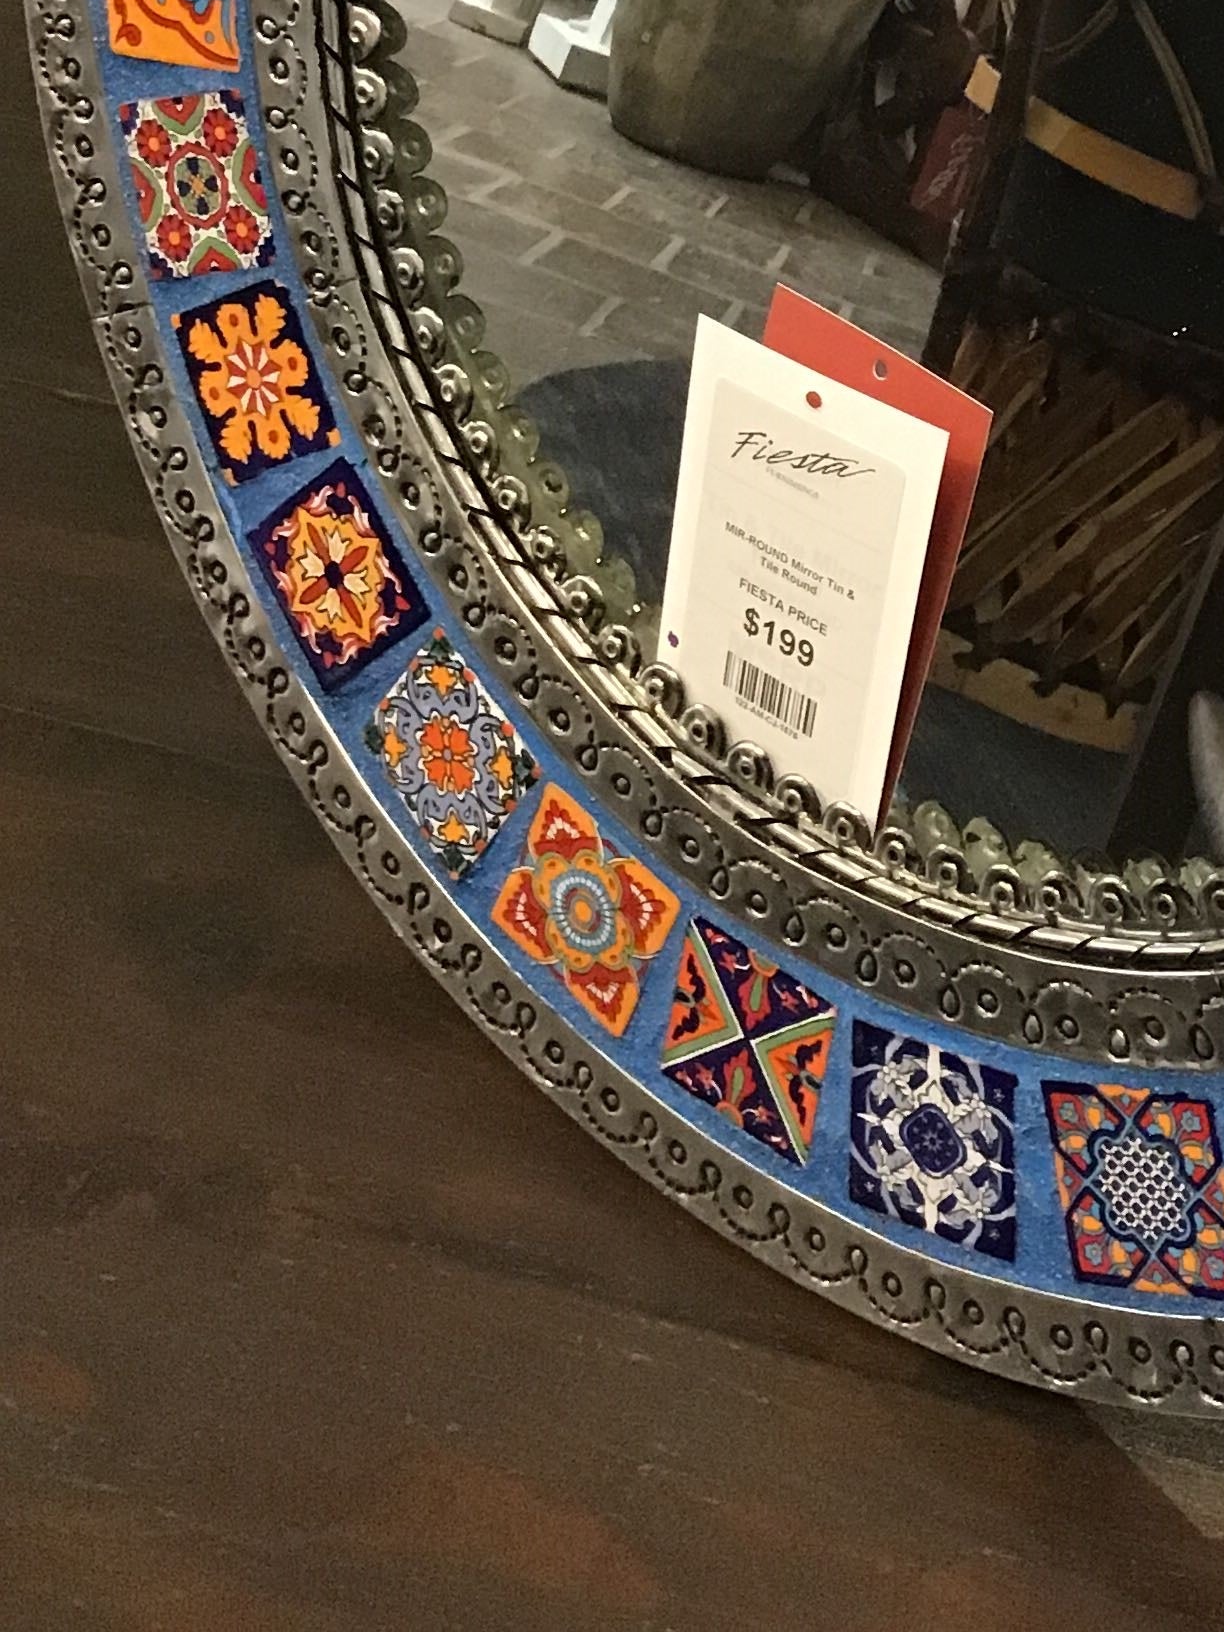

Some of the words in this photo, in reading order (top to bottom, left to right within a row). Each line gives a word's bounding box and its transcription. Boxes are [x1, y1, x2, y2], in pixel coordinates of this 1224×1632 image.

[731, 432, 876, 477] Fiesta
[725, 521, 788, 564] MIR-ROUND
[791, 558, 824, 583] Mirror
[827, 577, 844, 594] Tin
[846, 589, 855, 601] &
[760, 556, 779, 574] Tile
[781, 568, 818, 596] Round
[739, 577, 784, 612] FIESTA
[788, 605, 828, 637] PRICE
[743, 608, 814, 667] $199
